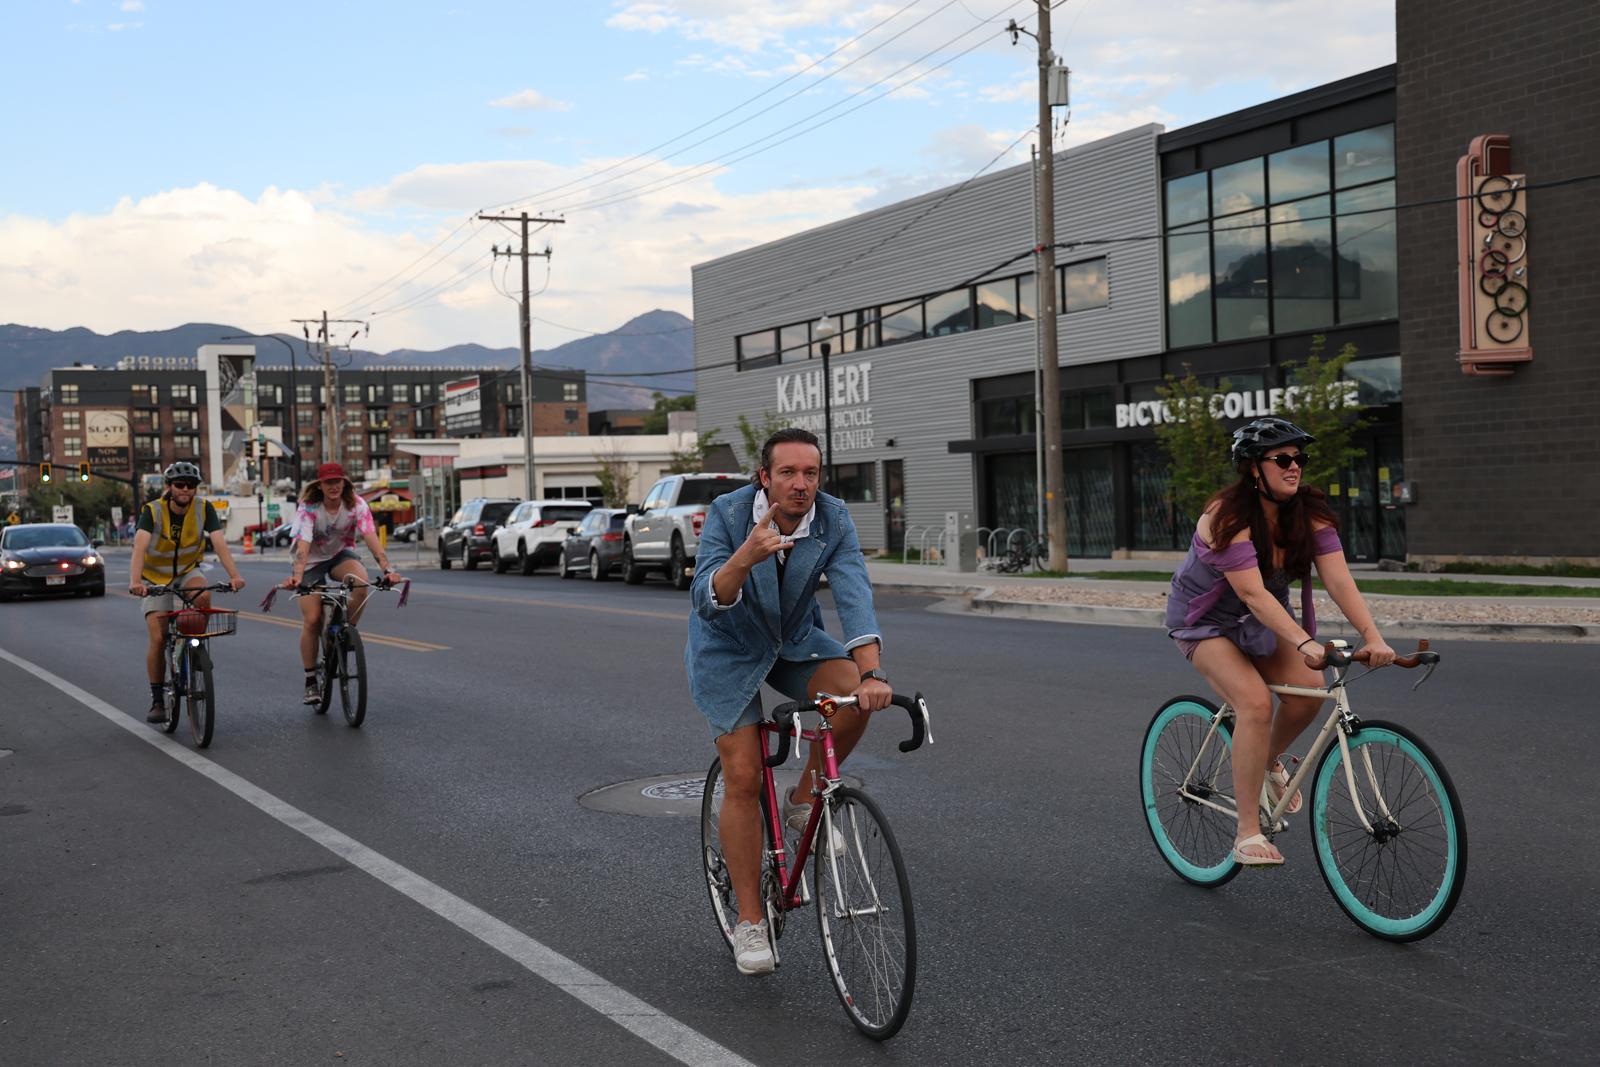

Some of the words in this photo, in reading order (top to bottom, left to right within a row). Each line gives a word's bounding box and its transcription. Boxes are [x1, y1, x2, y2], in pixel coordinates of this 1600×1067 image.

[833, 407, 873, 428] BICYCLE
[88, 425, 127, 433] SLATE
[832, 429, 874, 451] CENTER
